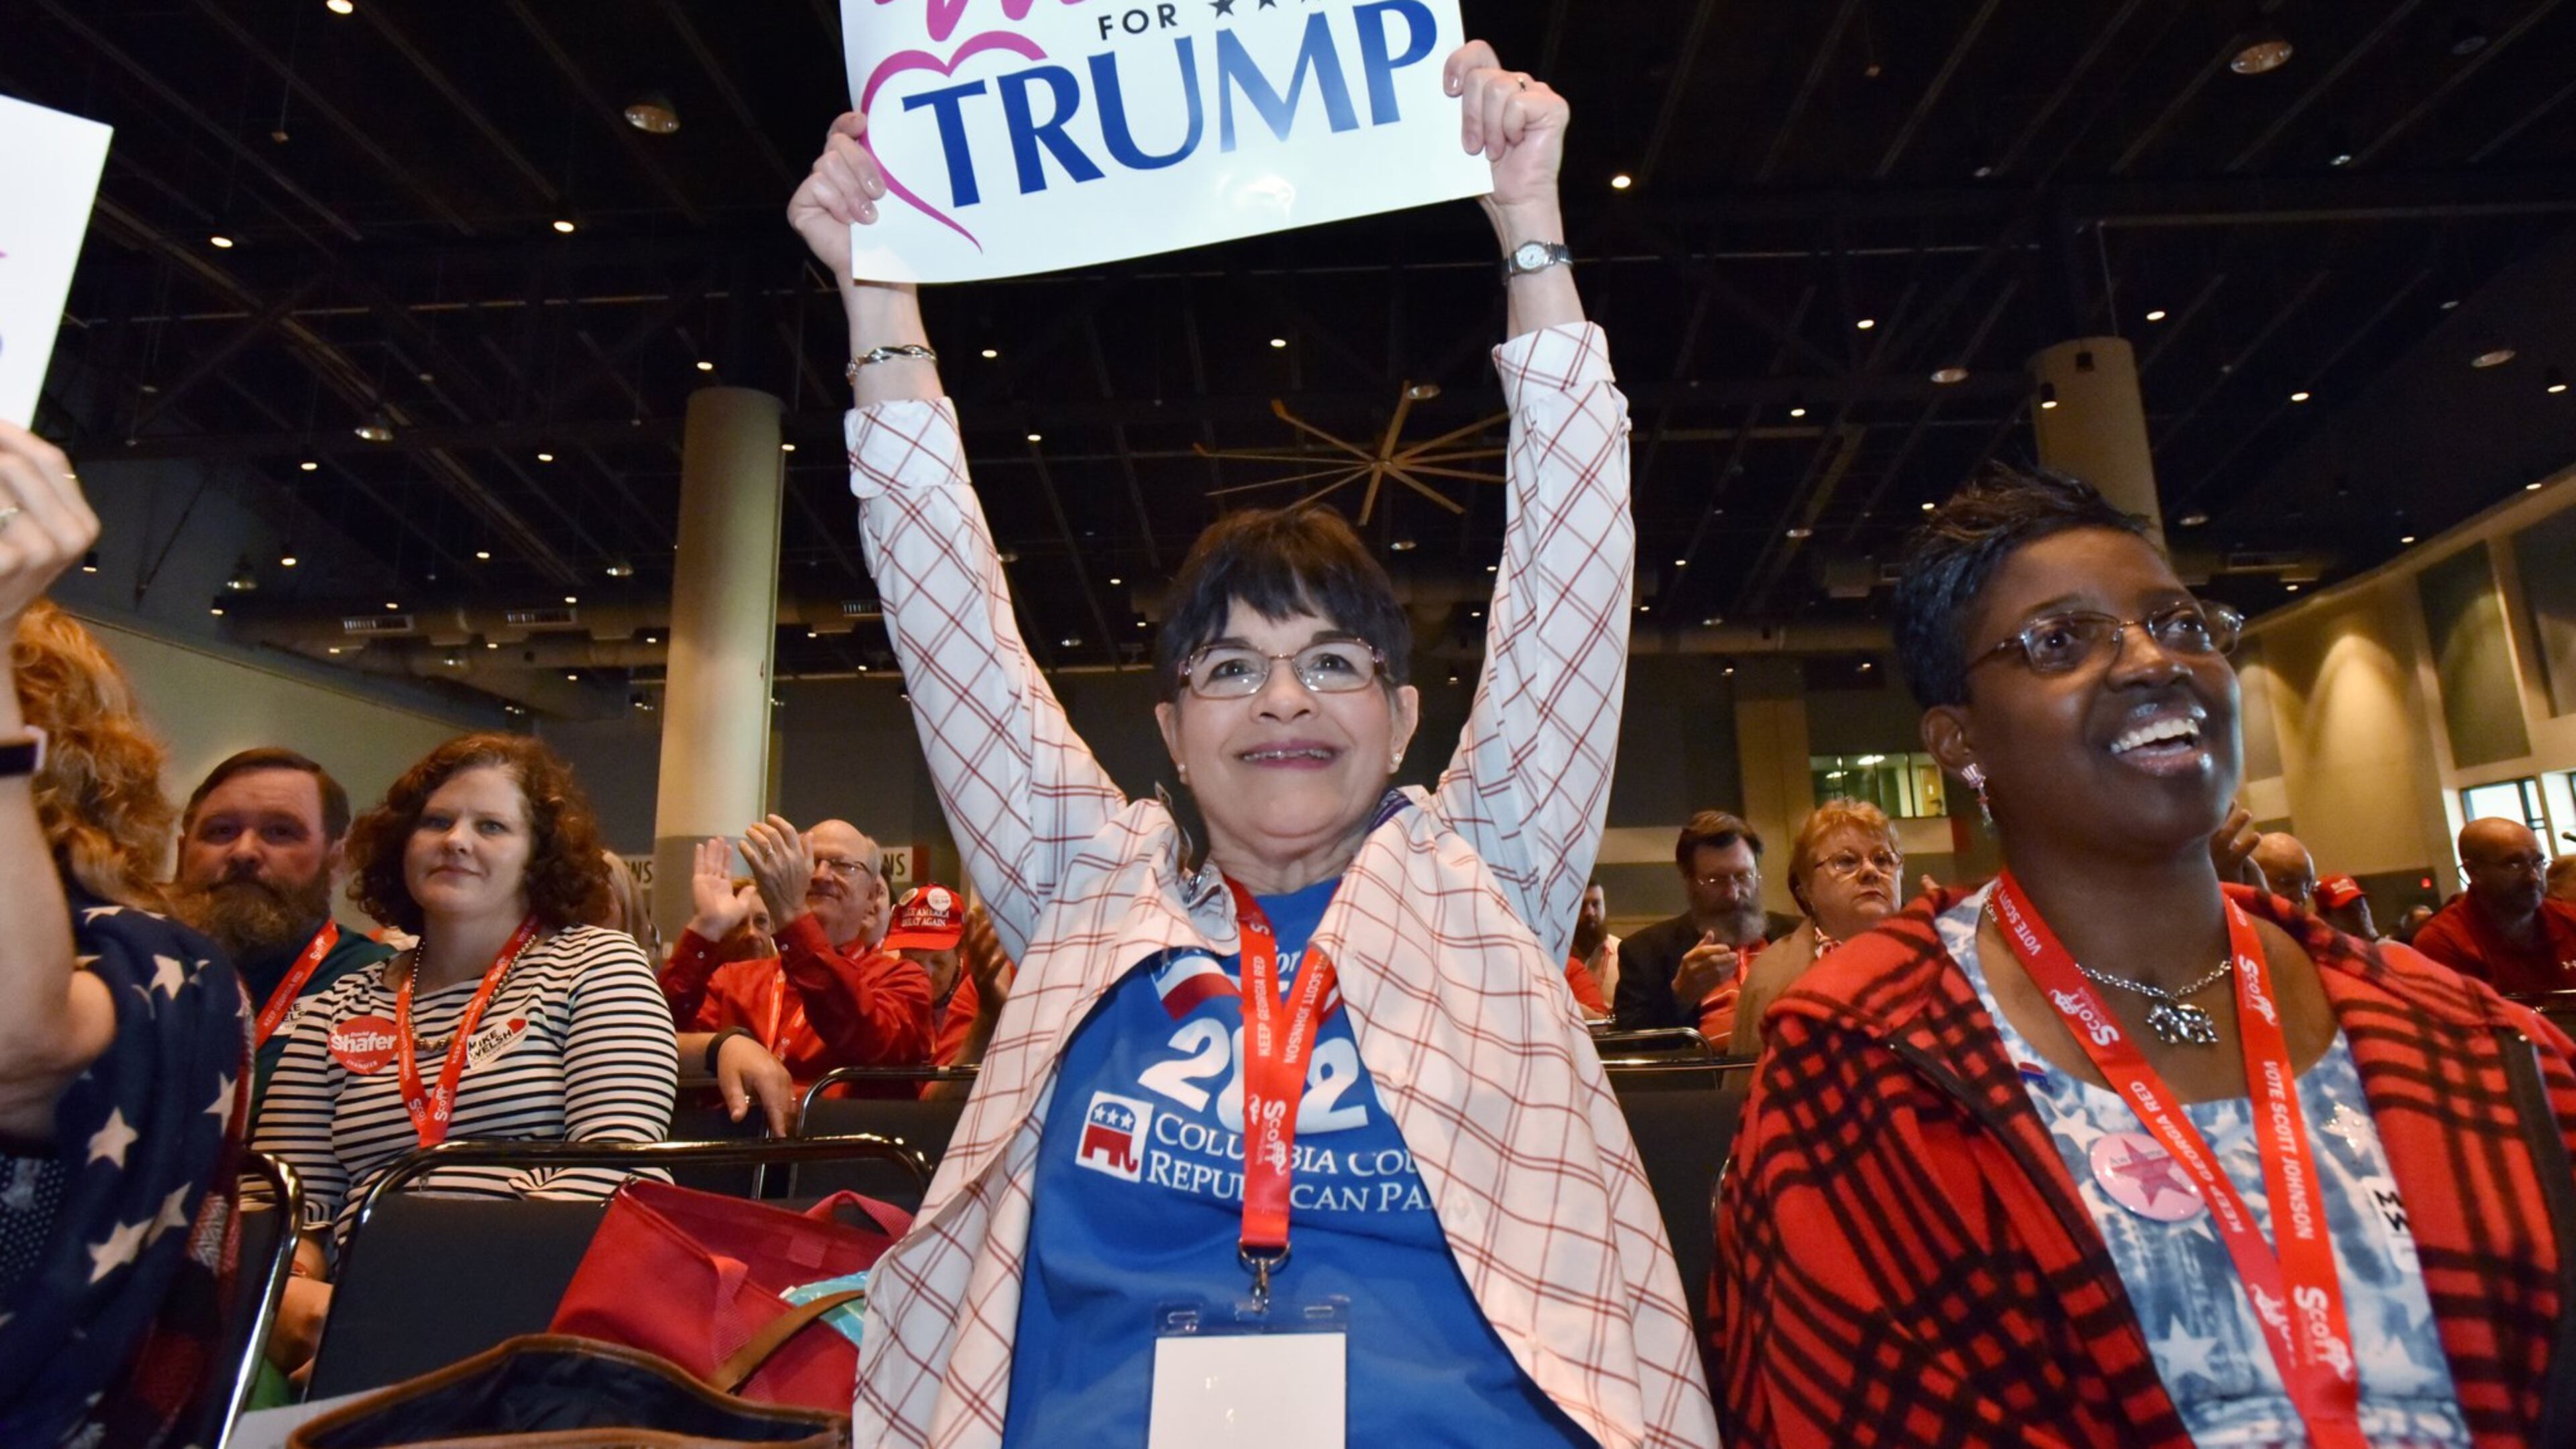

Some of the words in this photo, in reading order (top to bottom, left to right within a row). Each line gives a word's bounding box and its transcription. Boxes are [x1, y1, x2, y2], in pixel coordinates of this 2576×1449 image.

[1098, 3, 1177, 40] FOR
[901, 0, 1437, 209] TRUMP
[1253, 955, 1265, 977] RED
[1254, 979, 1270, 1020] GEORGIA
[330, 1032, 397, 1053] Shafer
[469, 1030, 497, 1051] MIKE
[469, 1029, 511, 1059] WELSH
[1257, 1022, 1271, 1057] KEEP
[1283, 1006, 1310, 1063] JOHNSON
[2131, 1081, 2161, 1113] RED
[2263, 1061, 2286, 1099] VOTE
[1155, 1112, 1338, 1175] COLUBIA
[2155, 1114, 2214, 1182] GEORGIA
[2271, 1101, 2298, 1155] SCOTT
[1146, 1149, 1370, 1212] REPUCAN
[2281, 1156, 2314, 1240] JOHNSON
[2209, 1184, 2244, 1232] KEEP
